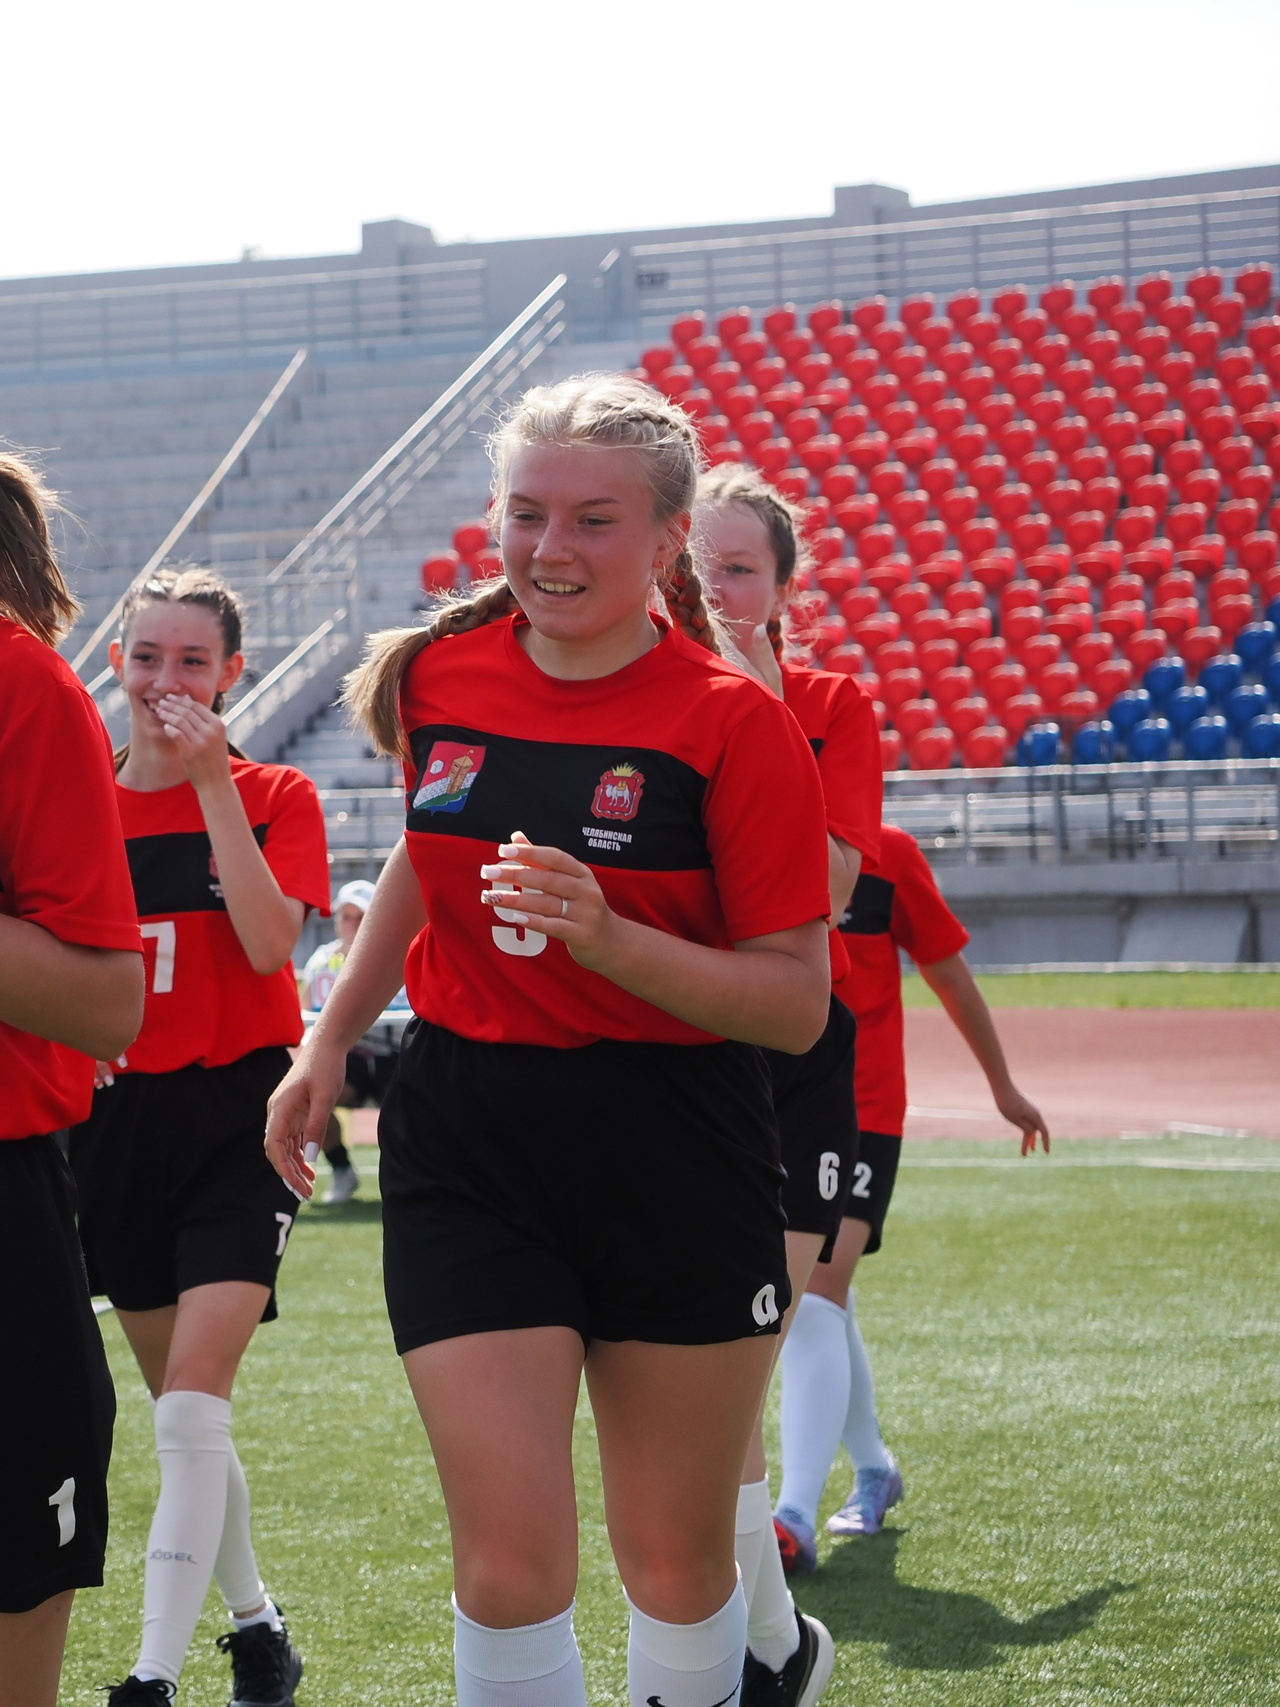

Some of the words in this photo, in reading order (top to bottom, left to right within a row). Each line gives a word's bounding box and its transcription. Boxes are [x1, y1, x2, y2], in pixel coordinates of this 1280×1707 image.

[581, 826, 633, 844] ЧЕЛЯБИНСКАЯ
[587, 837, 622, 852] ОБЛАСТЬ
[140, 920, 177, 994] 7
[818, 1151, 840, 1201] 6
[851, 1161, 873, 1199] 2
[274, 1211, 293, 1257] 7
[47, 1476, 77, 1548] 1
